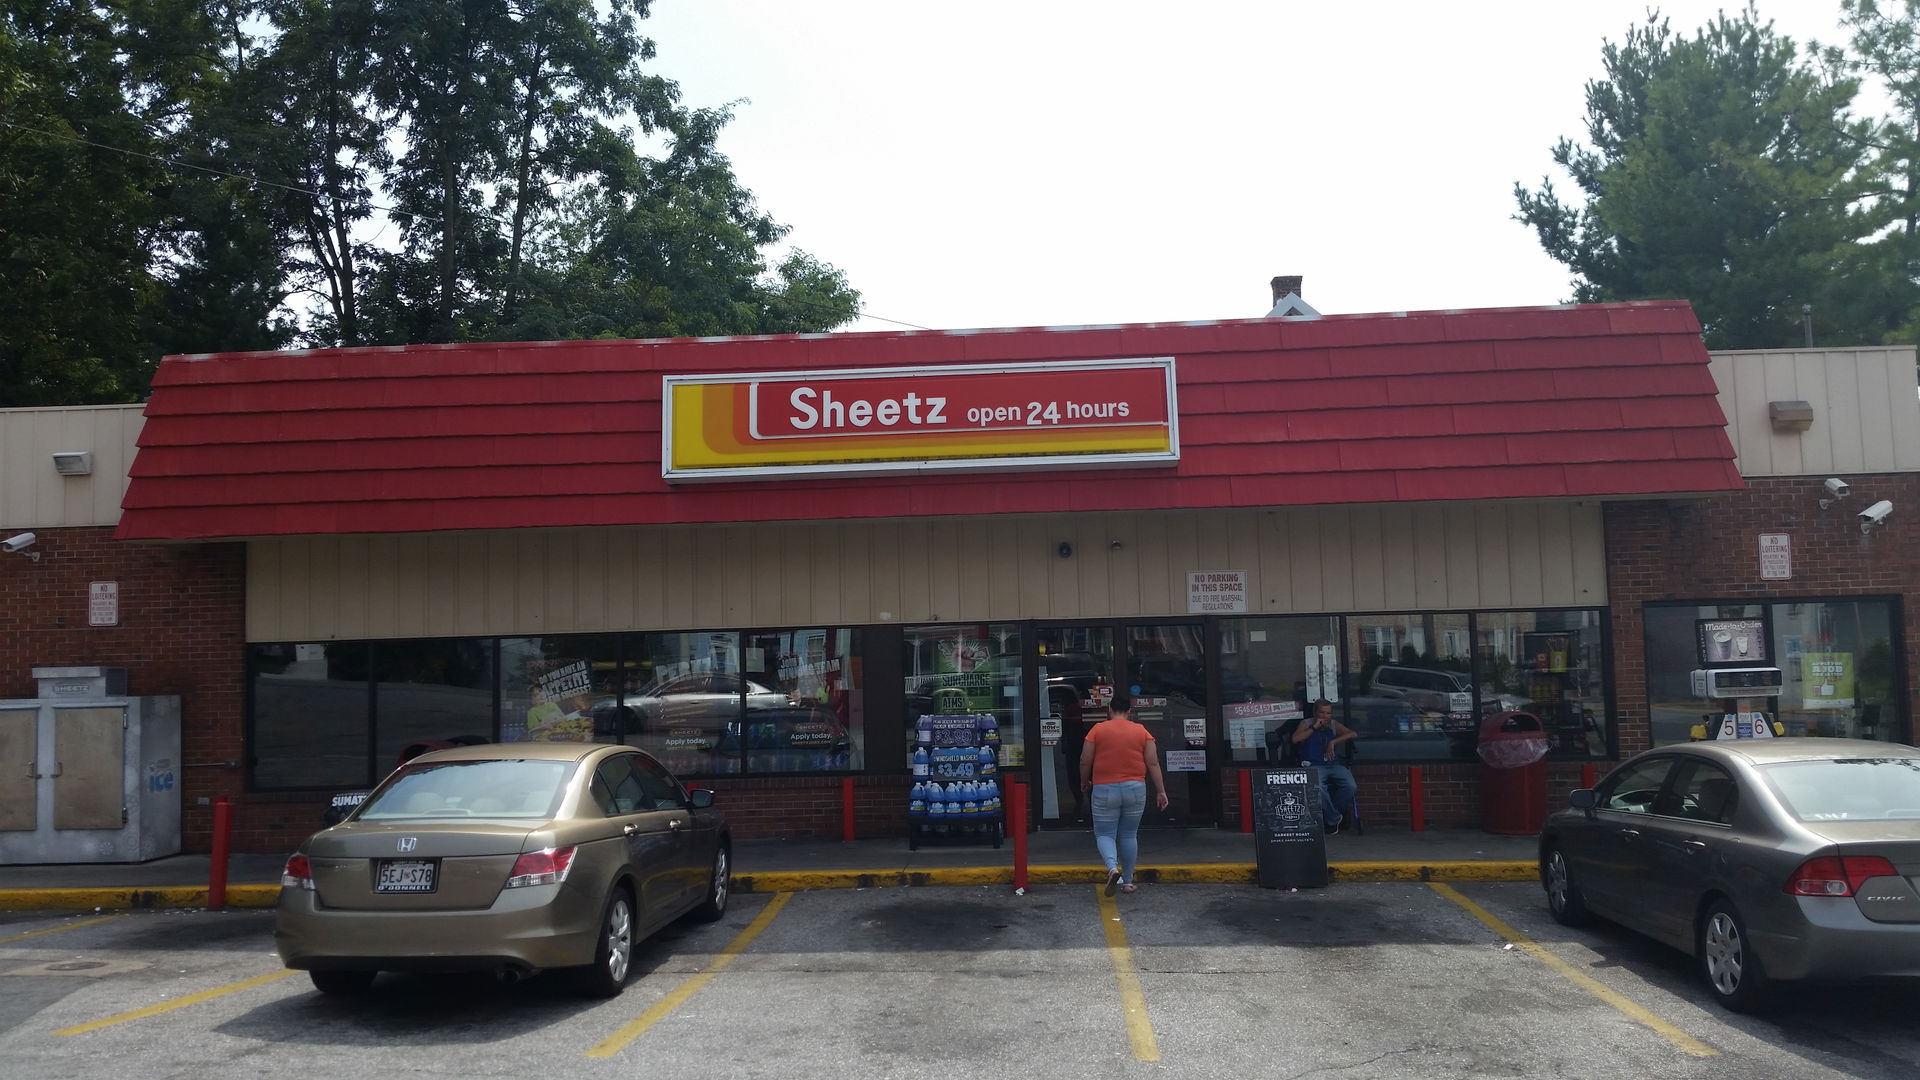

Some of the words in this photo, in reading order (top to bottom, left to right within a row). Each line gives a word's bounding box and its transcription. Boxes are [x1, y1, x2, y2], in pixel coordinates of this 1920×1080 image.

[790, 386, 947, 429] Sheetz
[967, 405, 1021, 426] open
[1026, 401, 1061, 425] 24
[1066, 401, 1130, 418] hours
[1770, 536, 1779, 545] NO
[1761, 545, 1789, 553] LOITERING
[1194, 574, 1206, 583] NO
[1207, 573, 1239, 583] PARKING
[1191, 584, 1200, 592] IN
[1201, 583, 1218, 592] THIS
[1219, 582, 1243, 591] SPACE
[547, 669, 561, 681] YOU
[560, 663, 578, 675] HAVE
[576, 660, 587, 671] AN
[542, 669, 590, 697] APPETITE
[942, 673, 991, 687] SURCHARGE
[1724, 720, 1734, 736] 5
[1754, 719, 1764, 734] 6
[665, 737, 685, 746] Apply
[790, 733, 810, 741] Apply
[812, 732, 833, 741] today.
[935, 729, 973, 744] $3.99
[937, 762, 975, 777] $3.49
[1266, 774, 1308, 785] FRENCH
[332, 795, 367, 807] SUMAT
[1279, 805, 1301, 813] SHEETZ
[382, 868, 403, 883] 5EJ
[411, 868, 432, 883] S78
